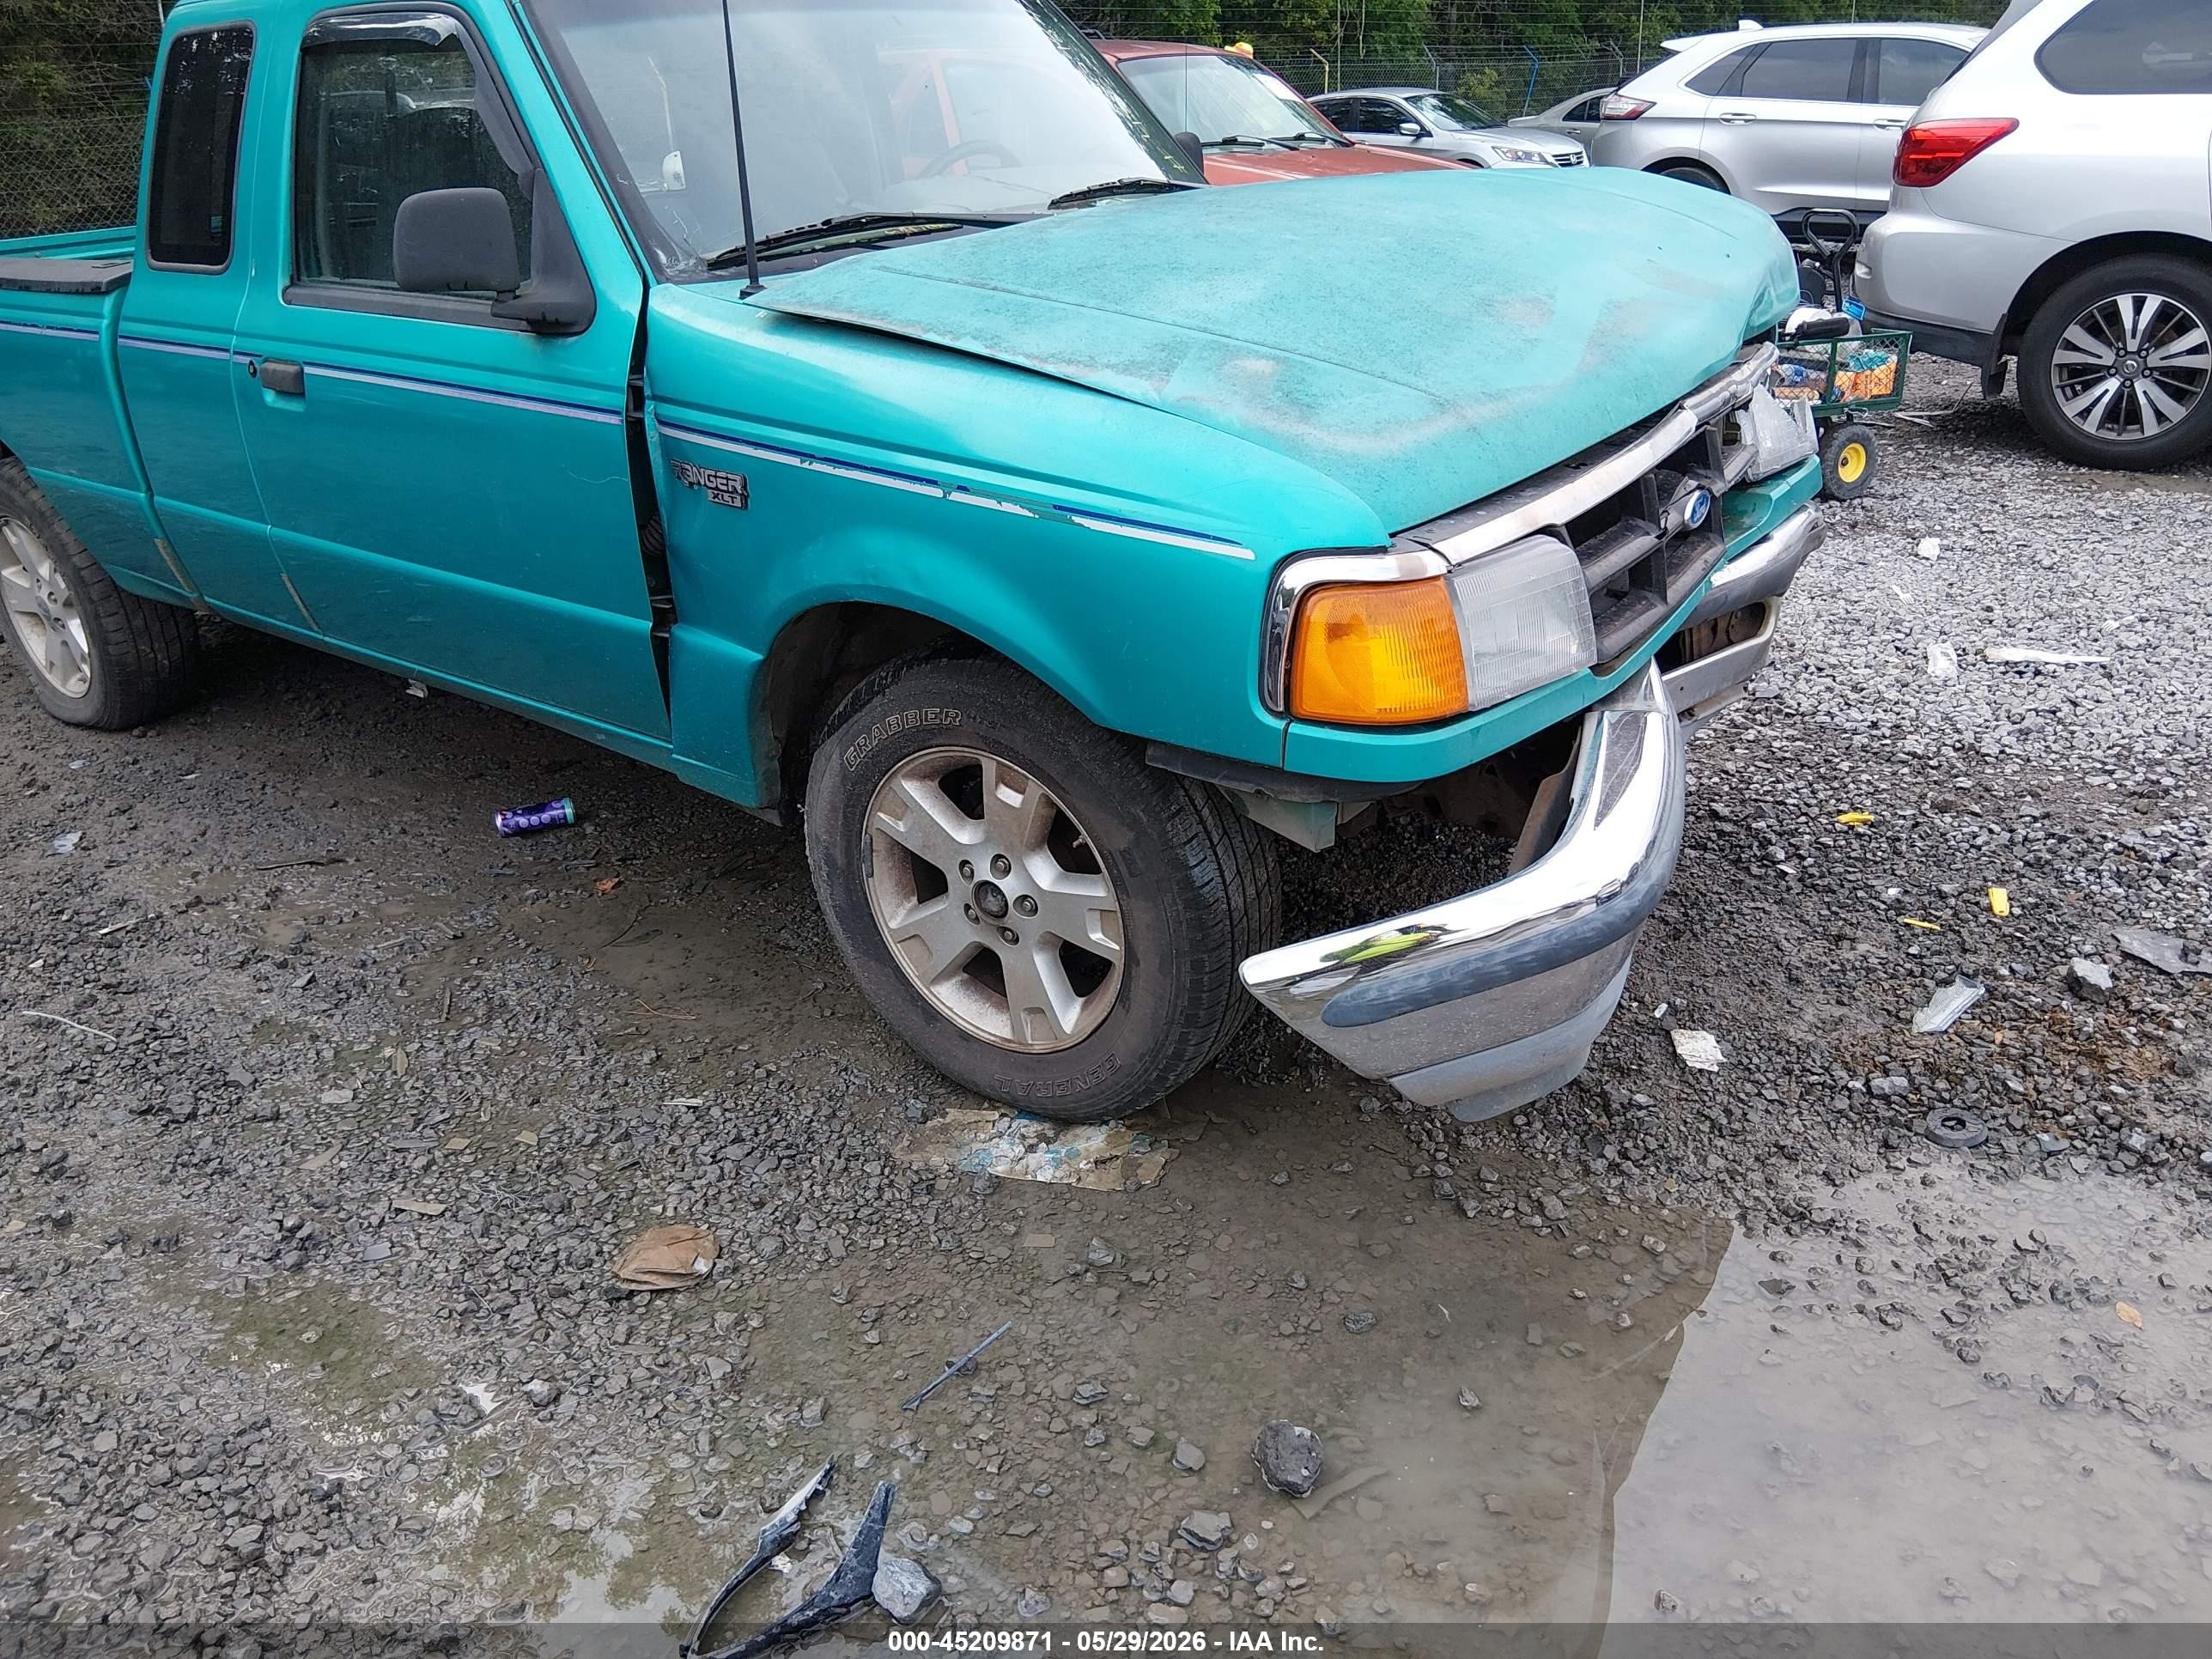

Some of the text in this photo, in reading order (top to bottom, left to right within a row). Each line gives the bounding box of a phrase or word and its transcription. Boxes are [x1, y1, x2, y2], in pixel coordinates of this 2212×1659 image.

[710, 490, 739, 506] XLT
[843, 708, 962, 772] GRABBER
[994, 1049, 1121, 1098] GENERAL
